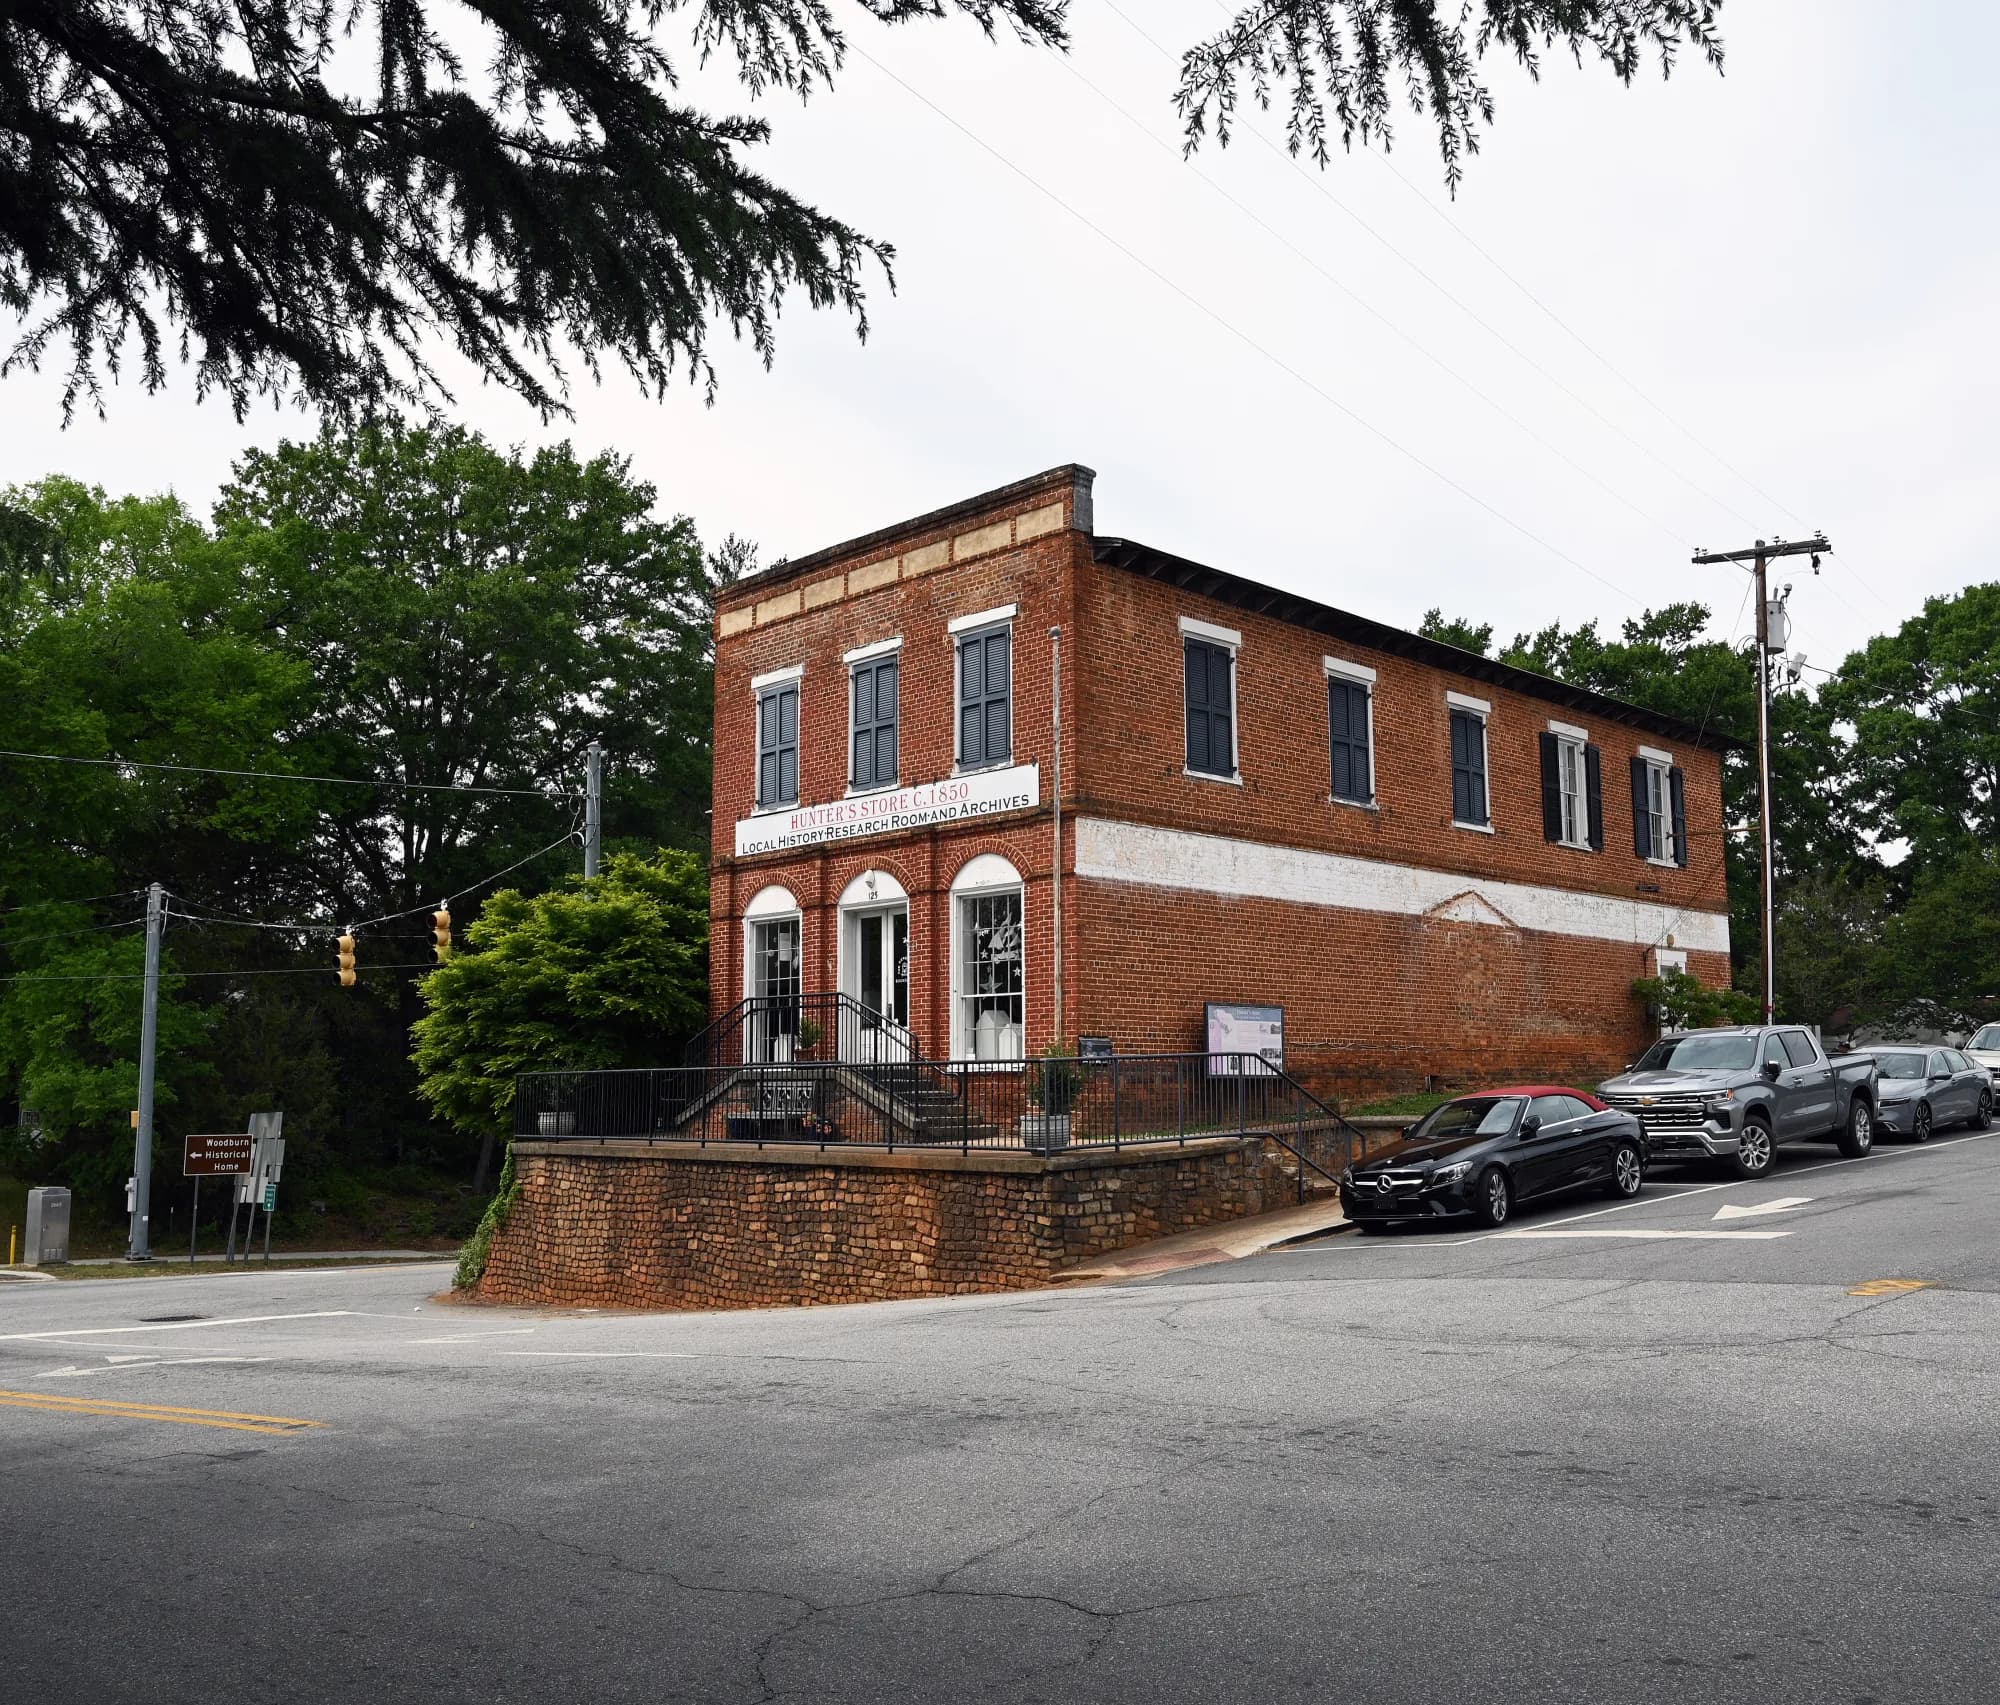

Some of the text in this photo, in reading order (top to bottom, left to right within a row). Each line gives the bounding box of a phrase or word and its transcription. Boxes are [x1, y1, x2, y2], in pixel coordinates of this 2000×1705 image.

[791, 783, 968, 829] HUNTER'S STORE C. 1850
[742, 794, 1029, 855] LOCAL HISTORY RESEARCH ROOM AND ARCHIVES
[868, 891, 878, 900] 125
[206, 1139, 249, 1147] Woodburn
[205, 1150, 249, 1159] Historical
[214, 1162, 239, 1171] Home
